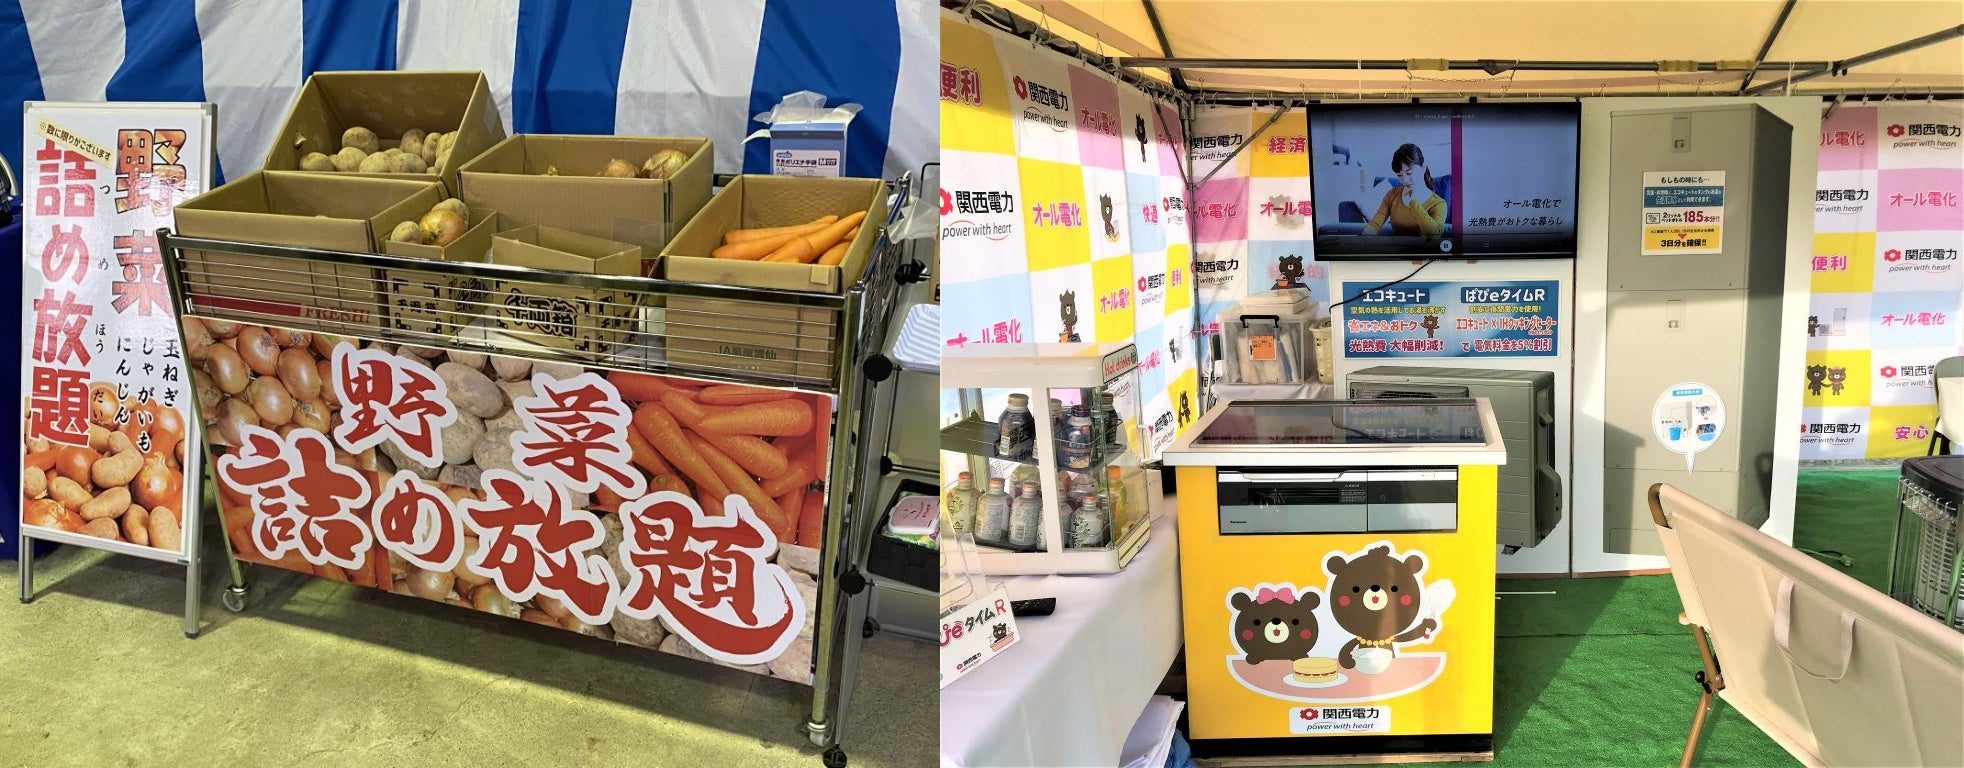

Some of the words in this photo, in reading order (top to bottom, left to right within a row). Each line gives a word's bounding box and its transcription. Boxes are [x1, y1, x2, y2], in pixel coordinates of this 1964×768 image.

[1028, 81, 1069, 112] 関西電力
[1023, 109, 1040, 123] power
[1040, 112, 1052, 125] with
[1053, 116, 1068, 129] heart
[1908, 123, 1961, 137] 関西電力
[1269, 137, 1306, 154] 経済
[1893, 140, 1918, 149] power
[1918, 139, 1936, 148] with
[1936, 139, 1957, 148] heart
[955, 190, 1014, 214] 関西電力
[1815, 189, 1869, 202] 関西電力
[1889, 191, 1957, 207] オール電化
[1503, 198, 1562, 210] オール電化で
[1824, 205, 1842, 213] with
[1842, 205, 1863, 213] heart
[1032, 202, 1082, 227] オール電化
[1468, 216, 1563, 228] 光熱費がおトクな暮らし
[111, 128, 187, 318] 野菜
[942, 225, 972, 241] power
[972, 222, 992, 237] with
[993, 222, 1012, 235] heart
[1904, 248, 1958, 261] 関西電力
[1812, 255, 1847, 271] 便利
[1888, 265, 1913, 273] power
[1913, 263, 1930, 271] with
[1931, 263, 1951, 271] heart
[31, 138, 97, 446] 詰め放題
[1361, 288, 1426, 303] エコキュート
[1880, 311, 1946, 327] オール電化
[1349, 339, 1387, 352] 光熱費
[1390, 339, 1444, 352] 大幅削減!
[114, 336, 131, 424] にんじん
[162, 338, 180, 408] 玉ねぎ
[137, 337, 155, 452] じゃがいも
[342, 358, 635, 489] 野菜
[1809, 422, 1861, 434] 関西電力
[1818, 436, 1835, 444] with
[1835, 436, 1855, 444] heart
[1895, 425, 1929, 441] 安心
[226, 432, 794, 656] 詰め放題
[1322, 707, 1380, 719] 関西電力
[1306, 723, 1332, 732] power
[1333, 722, 1351, 730] with
[1352, 722, 1374, 730] heart
